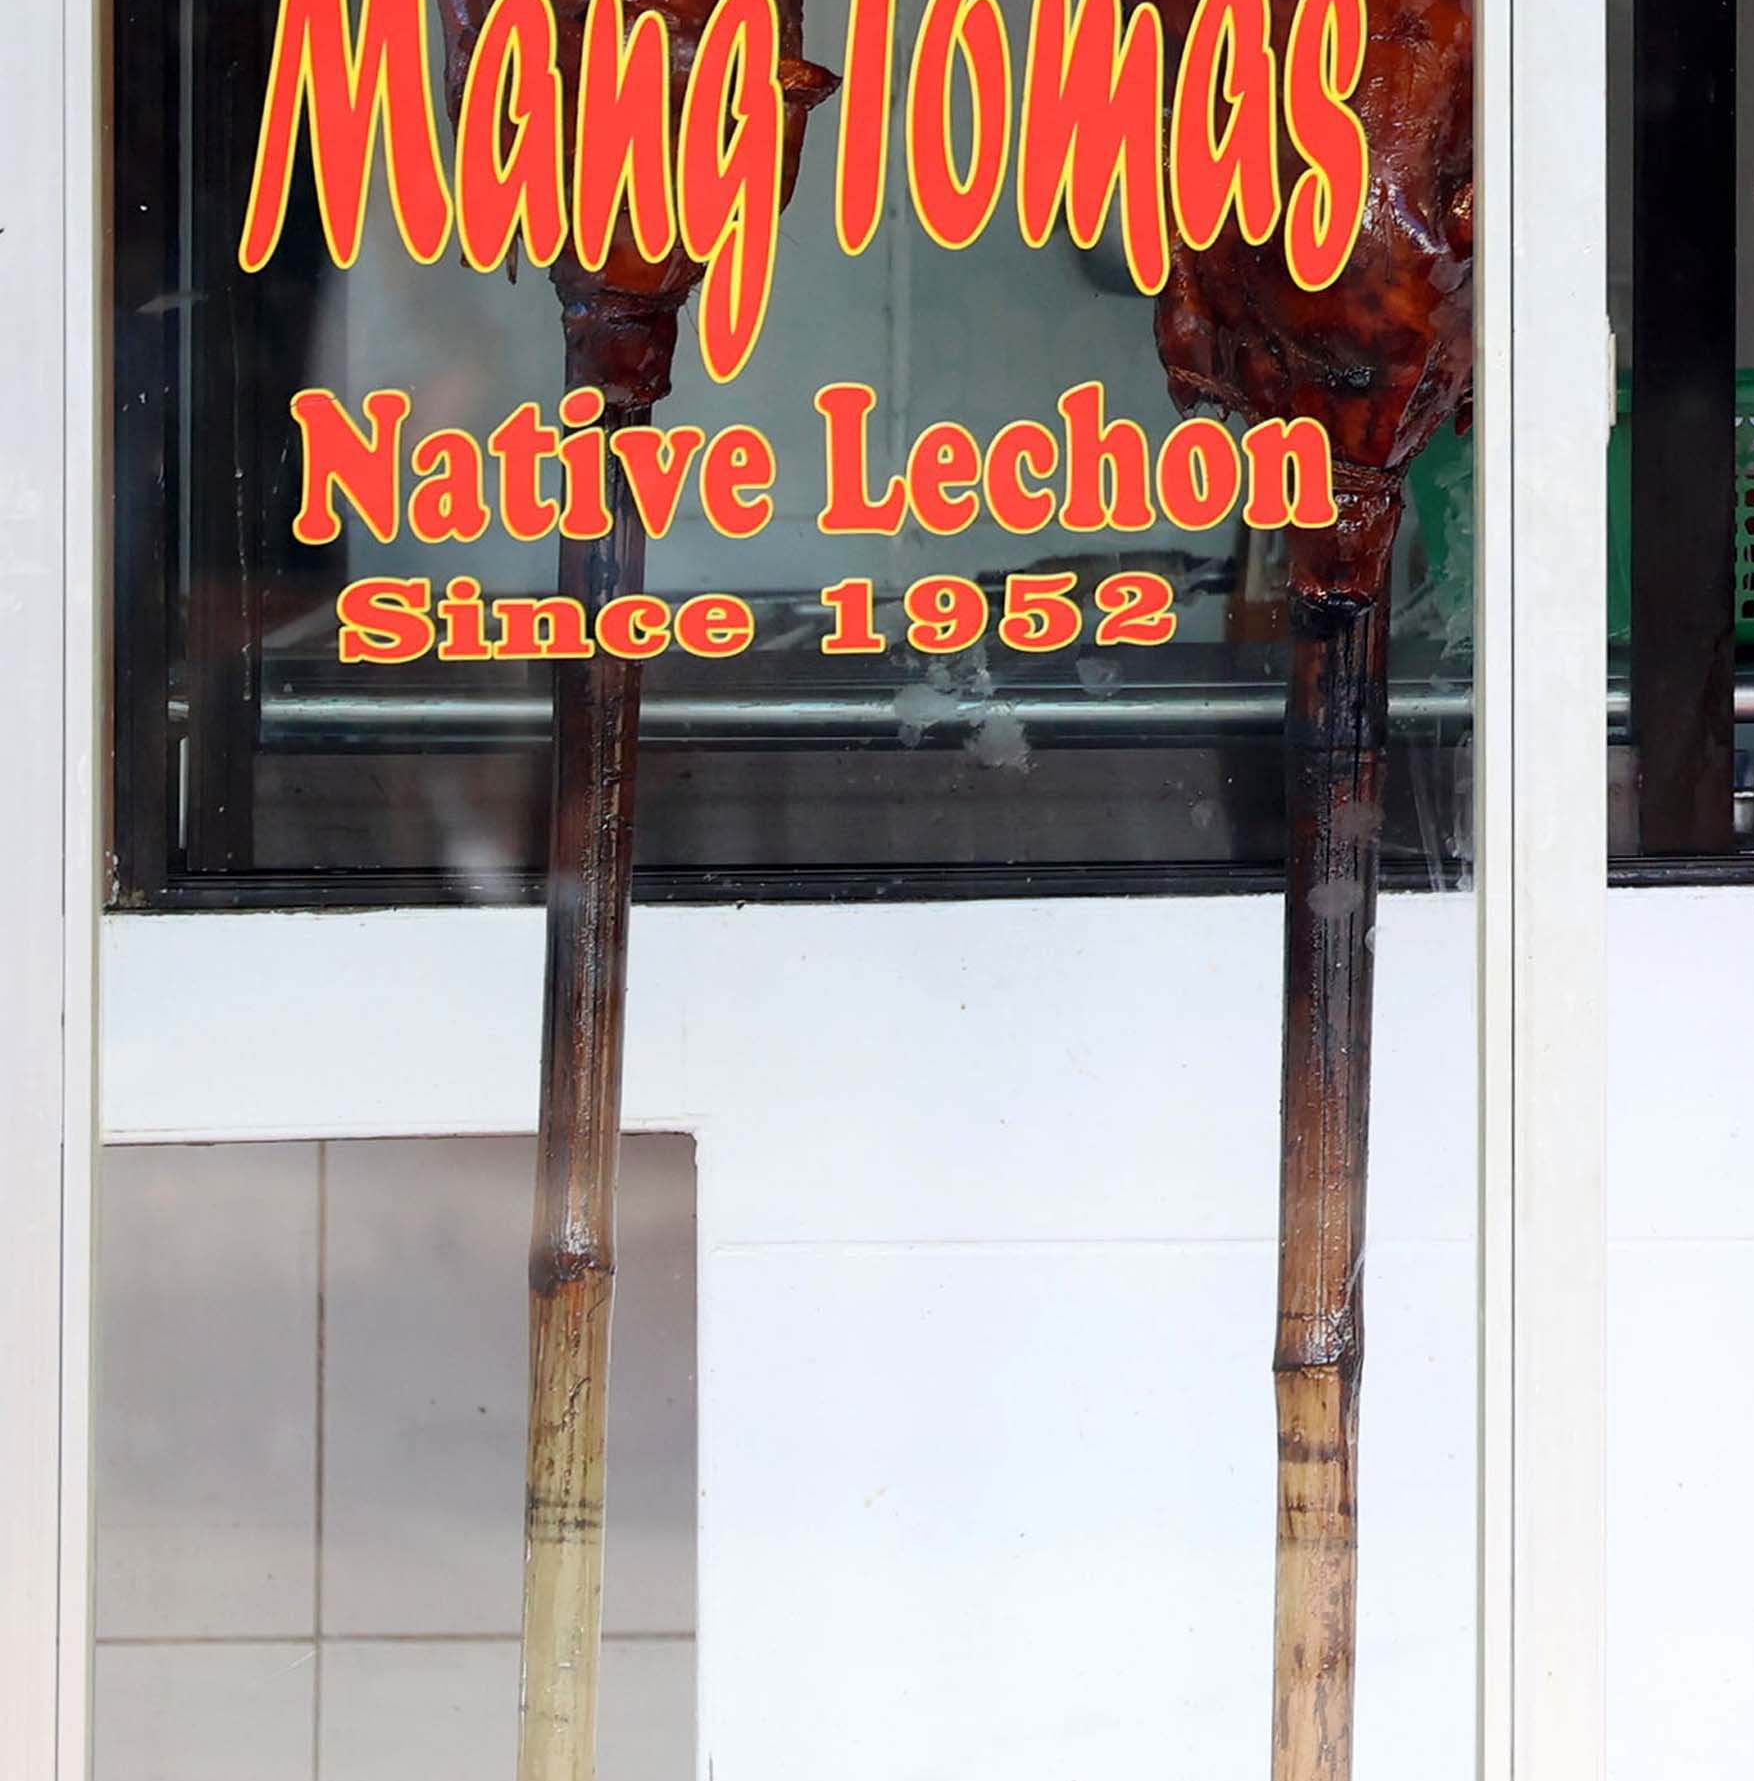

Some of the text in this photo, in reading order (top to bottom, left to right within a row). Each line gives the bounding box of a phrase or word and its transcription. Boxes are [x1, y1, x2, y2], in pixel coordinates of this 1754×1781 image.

[291, 382, 1338, 544] Native Lechon
[337, 572, 1177, 664] Since 1952
